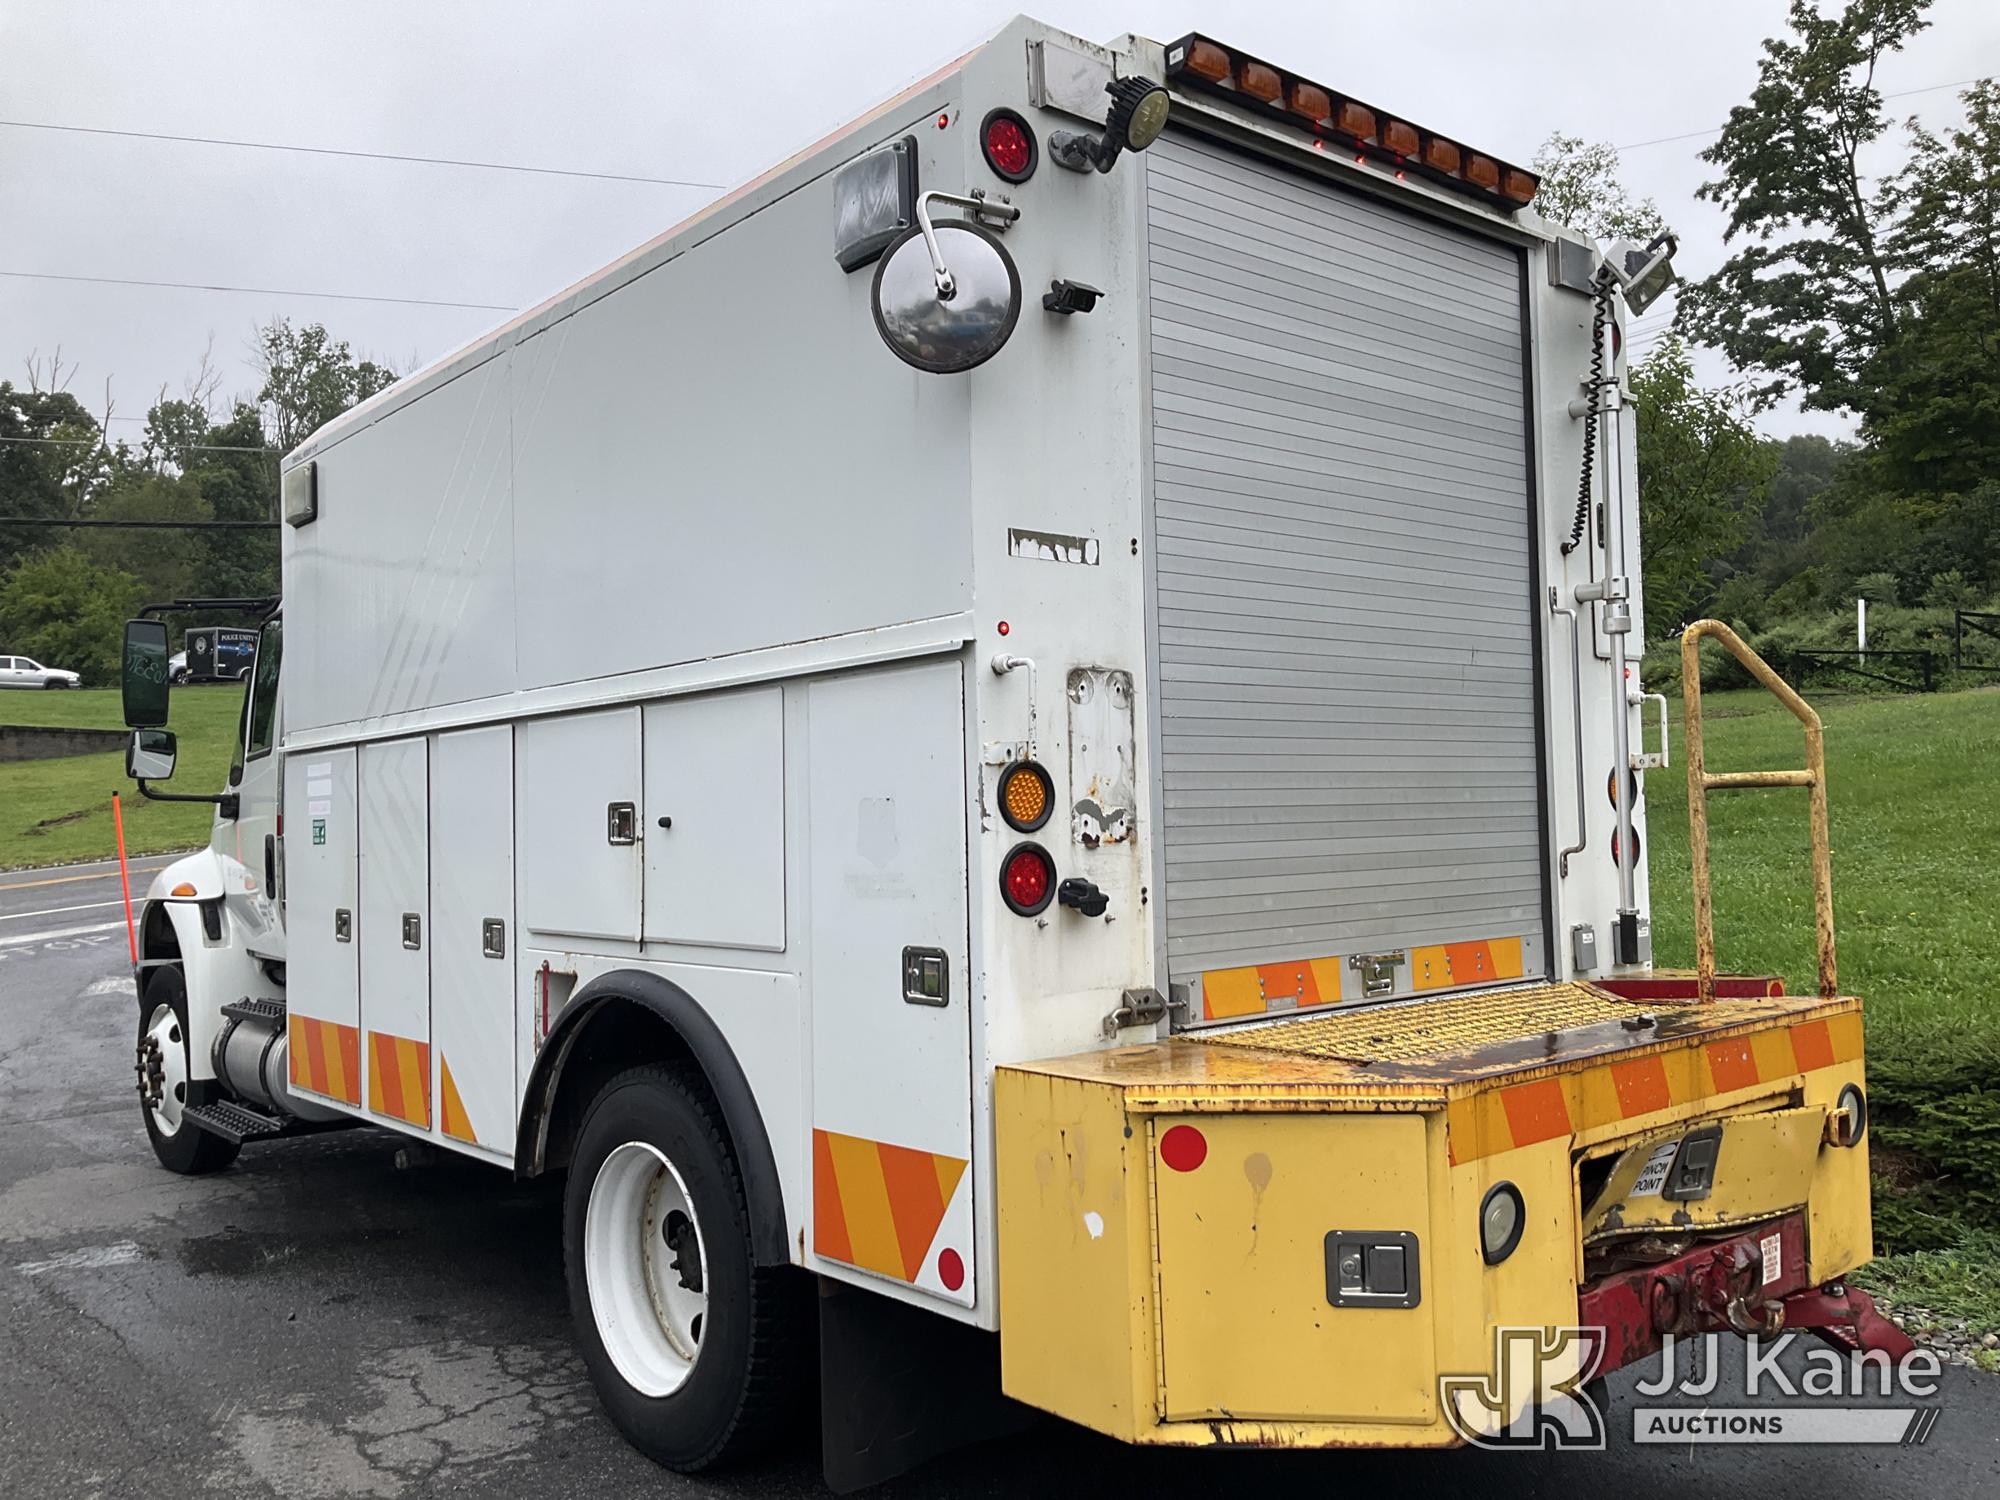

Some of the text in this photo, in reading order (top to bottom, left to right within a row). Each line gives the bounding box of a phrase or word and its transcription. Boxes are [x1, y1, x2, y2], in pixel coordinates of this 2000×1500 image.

[221, 633, 239, 642] POLICE
[0, 935, 111, 960] TOP
[1641, 1162, 1669, 1178] PINCH
[1633, 1177, 1663, 1193] POINT
